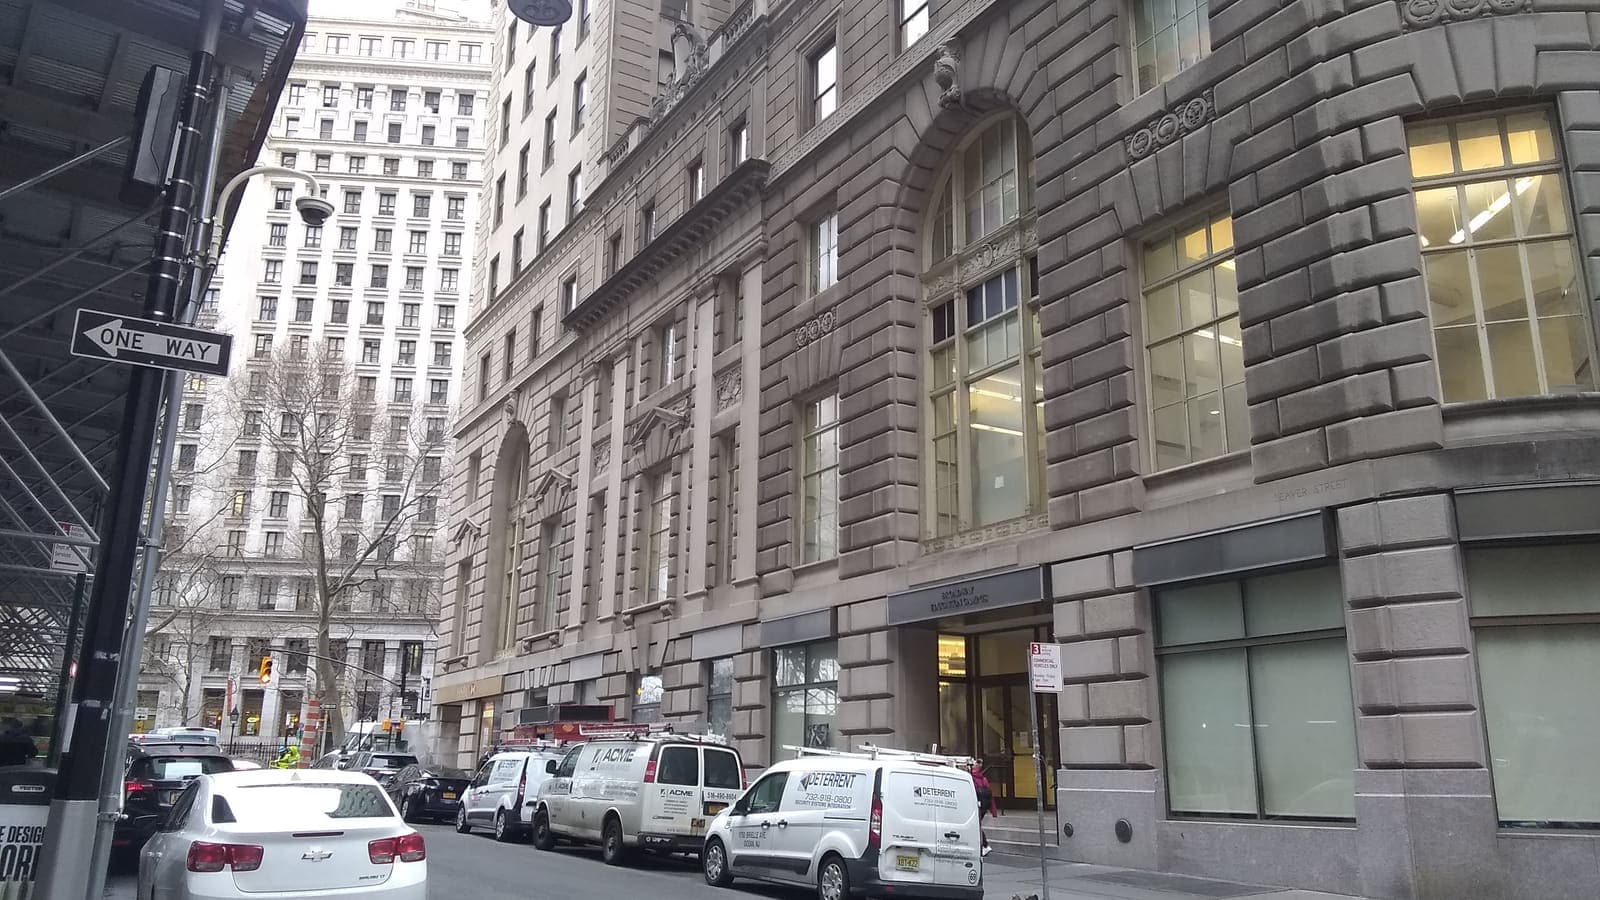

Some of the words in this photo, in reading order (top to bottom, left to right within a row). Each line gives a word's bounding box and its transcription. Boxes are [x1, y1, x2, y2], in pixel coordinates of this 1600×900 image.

[101, 328, 145, 350] ONE
[166, 338, 212, 361] WAY
[1033, 644, 1040, 655] 3
[603, 748, 636, 762] ACME
[807, 772, 857, 789] DETERRENT
[669, 789, 694, 797] ACME
[922, 787, 956, 798] DETERRENT
